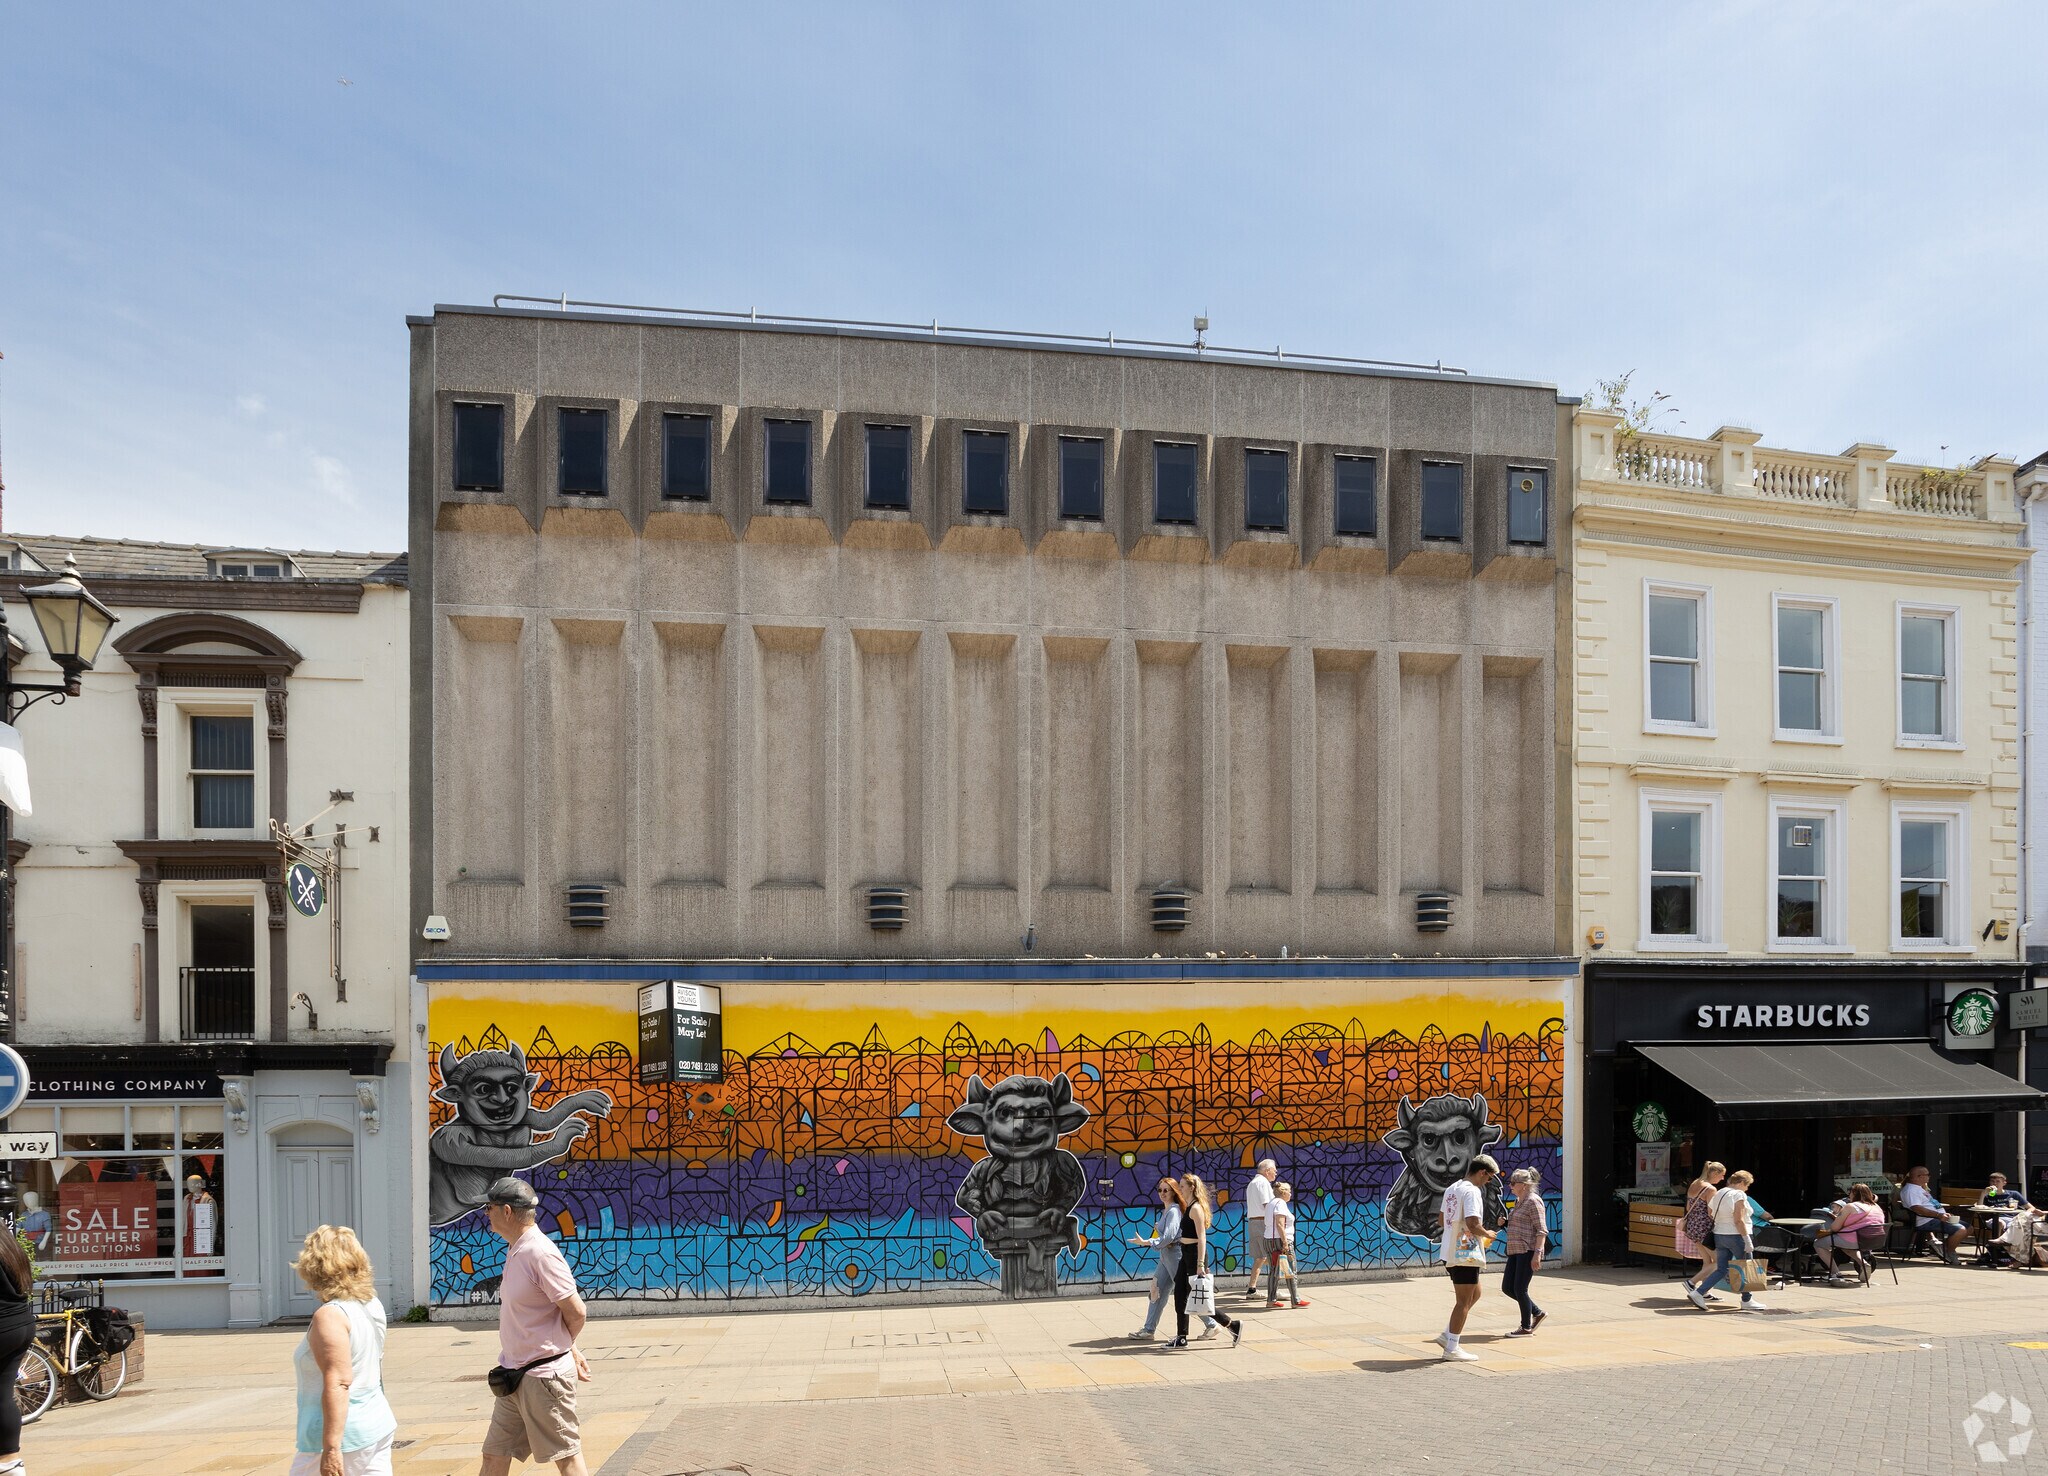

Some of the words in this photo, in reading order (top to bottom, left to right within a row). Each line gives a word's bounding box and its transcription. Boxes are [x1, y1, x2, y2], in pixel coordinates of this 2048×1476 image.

[677, 989, 697, 997] AVISON
[677, 995, 697, 1004] YOUNG
[677, 1014, 690, 1025] For
[691, 1016, 707, 1027] Sale
[1697, 1004, 1870, 1028] STARBUCKS
[648, 1017, 658, 1028] Sale
[650, 1030, 658, 1039] Let
[677, 1026, 695, 1040] May
[696, 1028, 707, 1039] Let
[679, 1060, 691, 1070] 020
[691, 1061, 703, 1071] 7491
[703, 1062, 719, 1072] 2188
[28, 1081, 116, 1091] CLOTHING
[124, 1080, 207, 1091] COMPANY
[10, 1142, 49, 1153] way
[65, 1207, 150, 1231] SALE
[1639, 1214, 1673, 1225] STARBUCKS
[55, 1231, 140, 1244] FURTHER
[55, 1244, 141, 1254] REDUCTIONS
